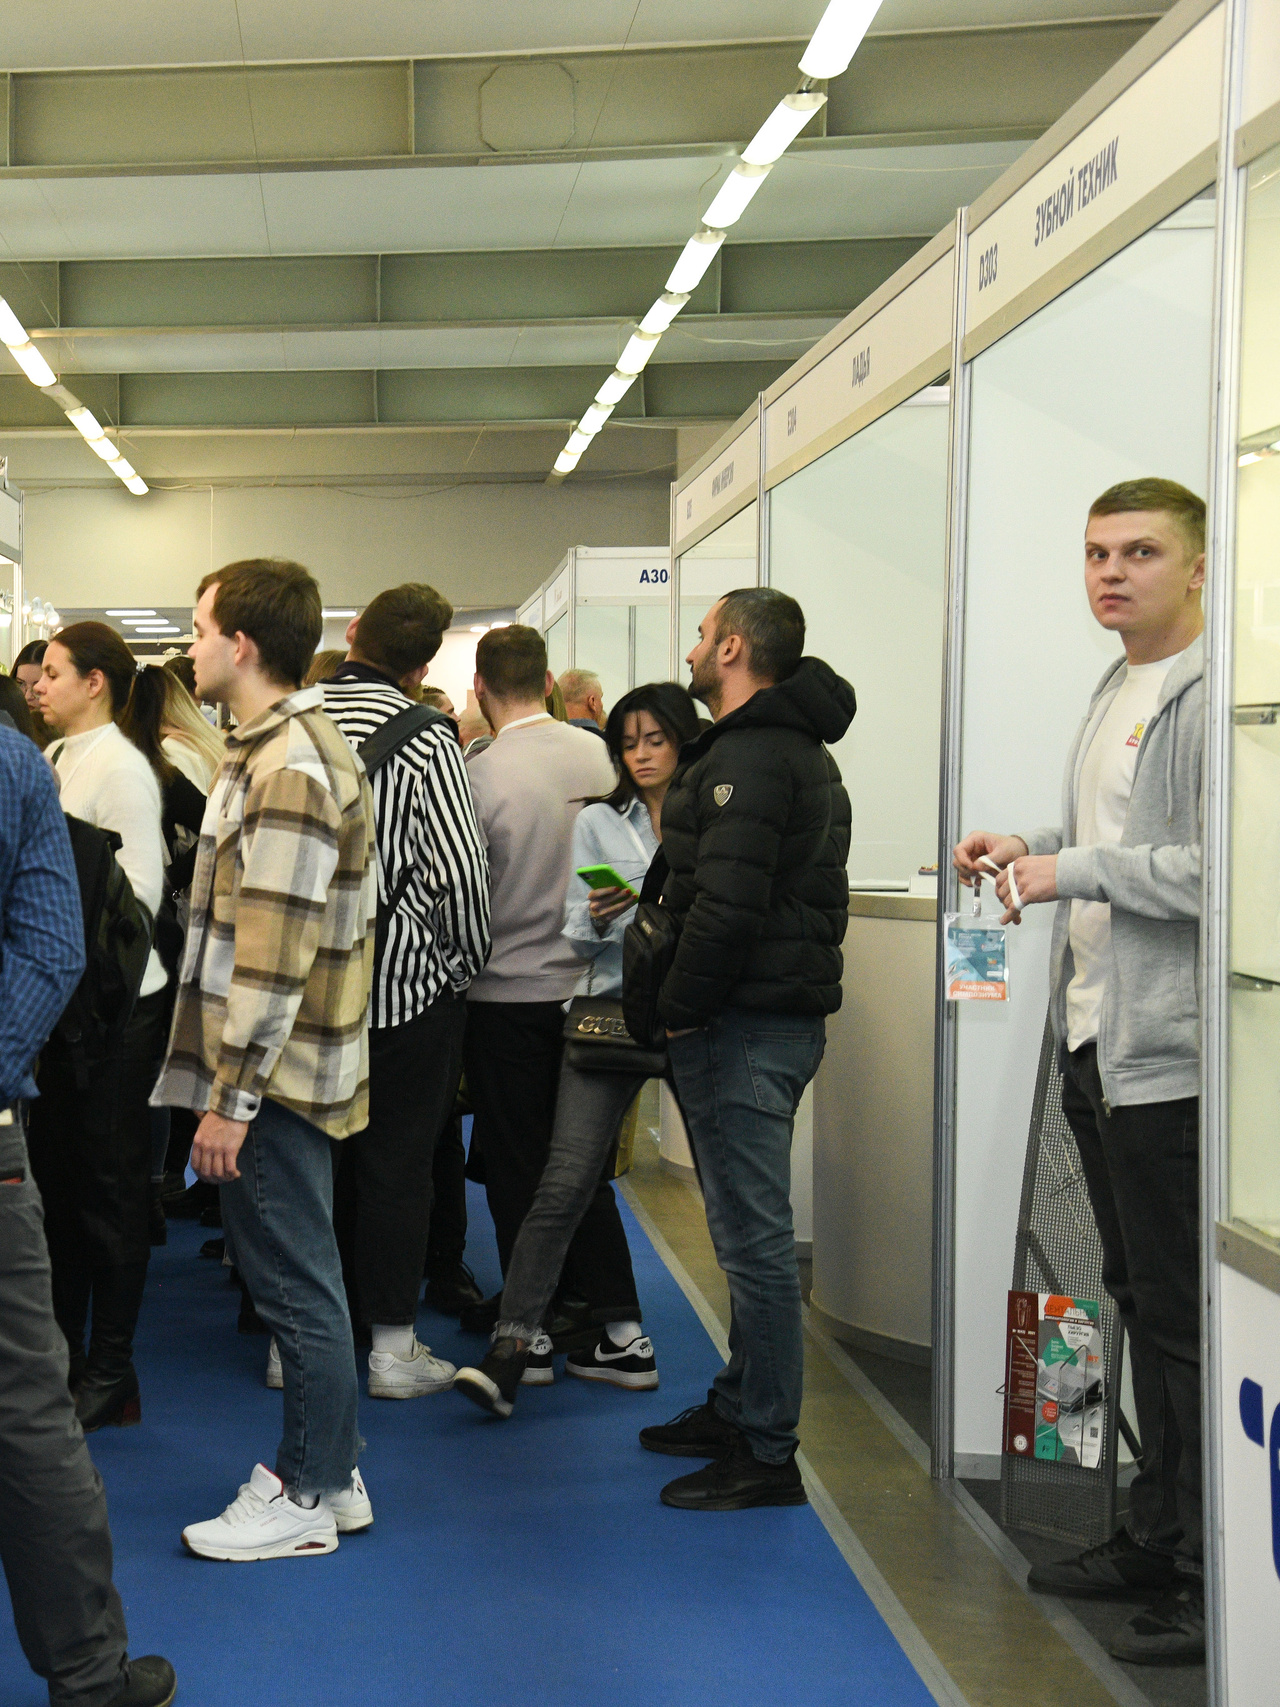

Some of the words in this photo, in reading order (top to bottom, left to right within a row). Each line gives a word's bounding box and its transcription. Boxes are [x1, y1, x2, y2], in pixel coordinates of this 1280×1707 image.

[1034, 166, 1075, 247] ЗУБНОЙ
[1077, 135, 1119, 212] ТЕХНИК
[978, 242, 998, 292] D303
[639, 568, 670, 584] A30
[952, 990, 1003, 999] СИМПОЗИУМА
[959, 983, 996, 991] УЧАСТНИК
